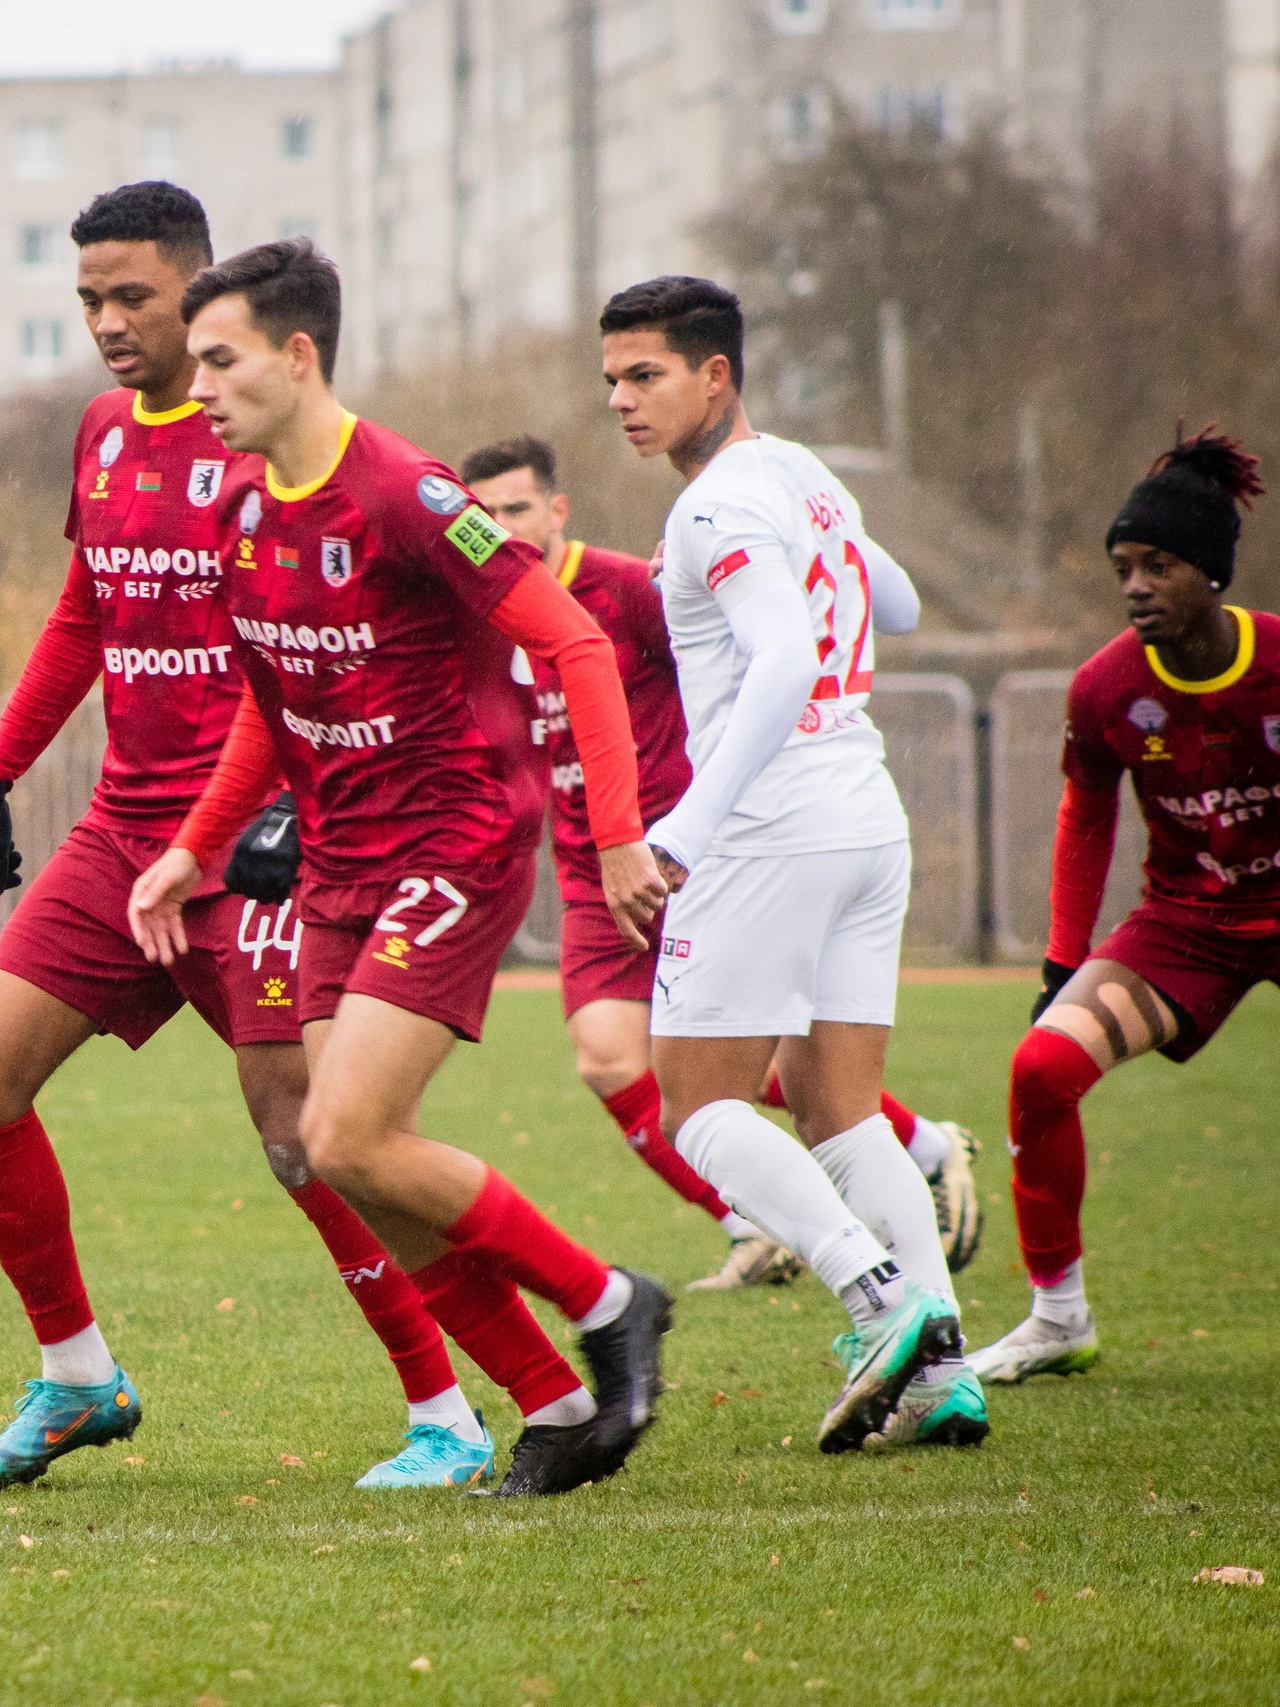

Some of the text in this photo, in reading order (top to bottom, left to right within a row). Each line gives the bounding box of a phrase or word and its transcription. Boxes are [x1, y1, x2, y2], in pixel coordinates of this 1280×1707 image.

[124, 580, 162, 599] БЕТ
[232, 616, 376, 653] МАРАФОН
[282, 655, 315, 676] БЕТ
[374, 876, 468, 946] 27
[238, 899, 305, 971] 44
[256, 998, 293, 1006] KELME
